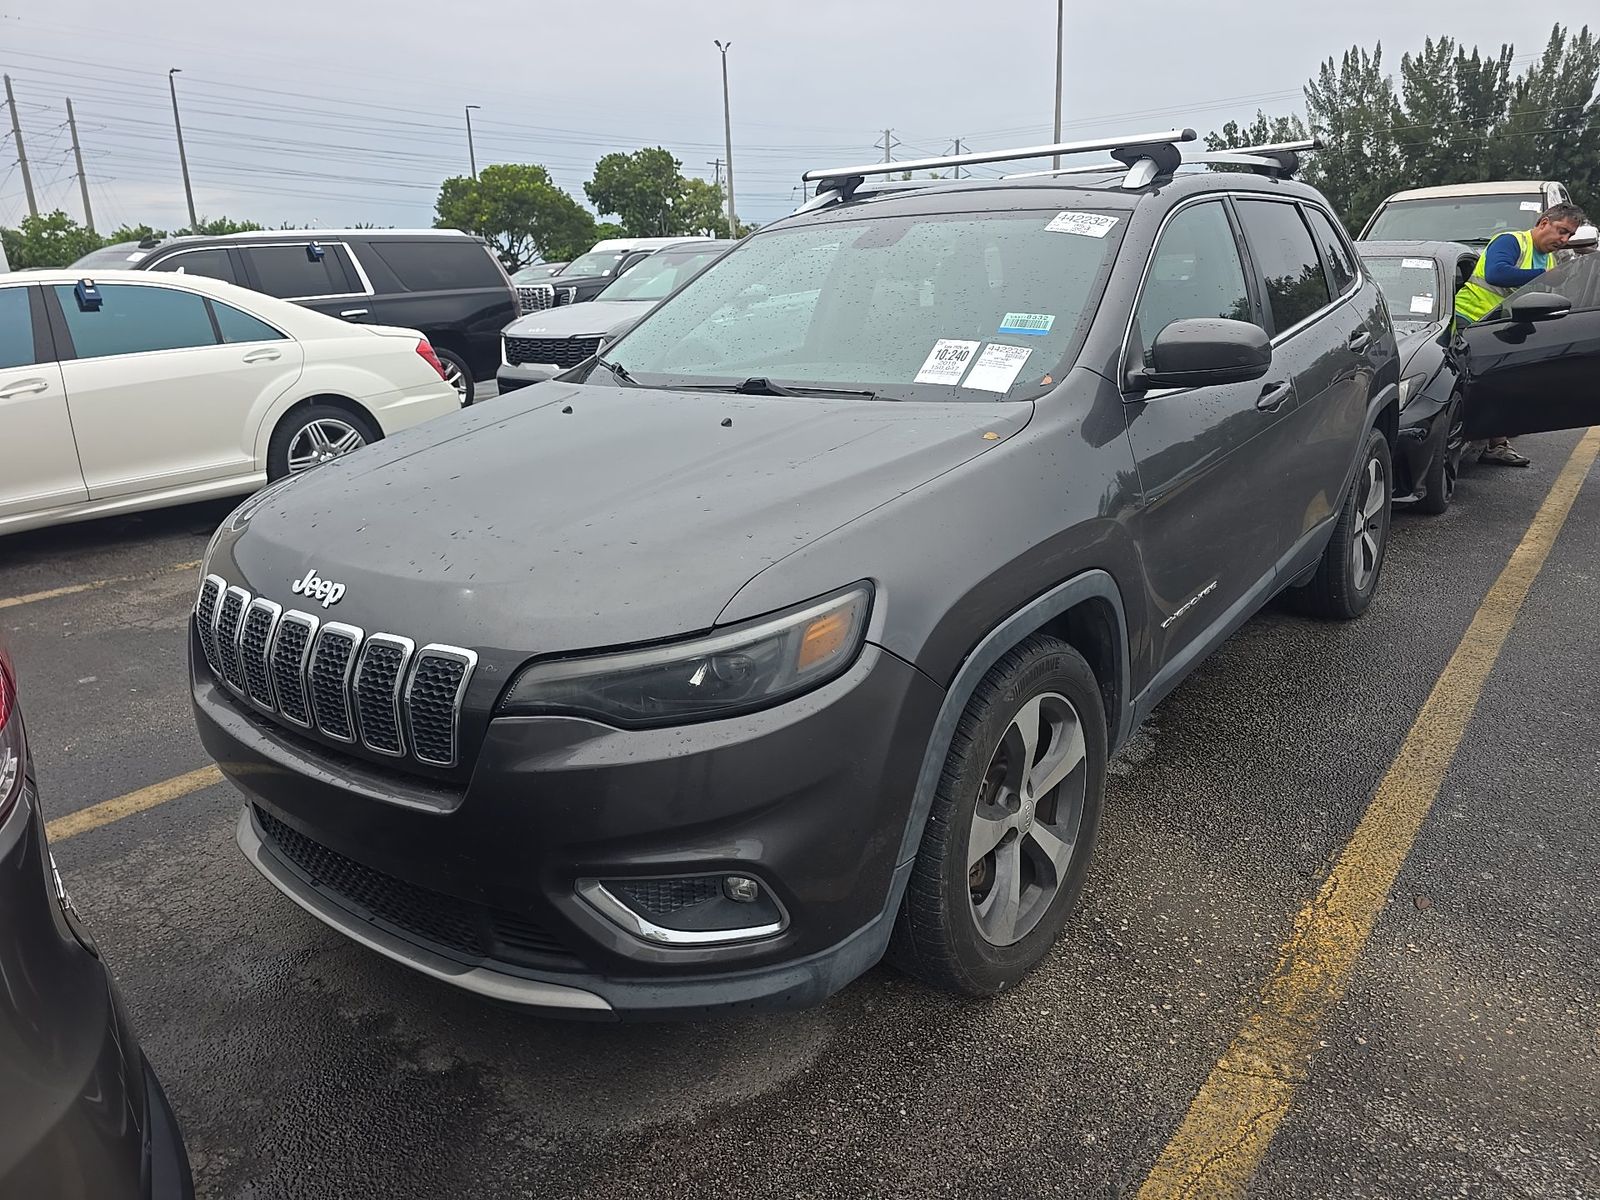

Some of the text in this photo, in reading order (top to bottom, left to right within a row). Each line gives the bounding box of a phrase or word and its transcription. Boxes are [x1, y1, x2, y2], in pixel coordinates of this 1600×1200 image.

[1059, 214, 1116, 227] 4422321
[934, 348, 970, 362] 10:240
[988, 345, 1030, 355] 4422321
[292, 569, 346, 609] Jeep
